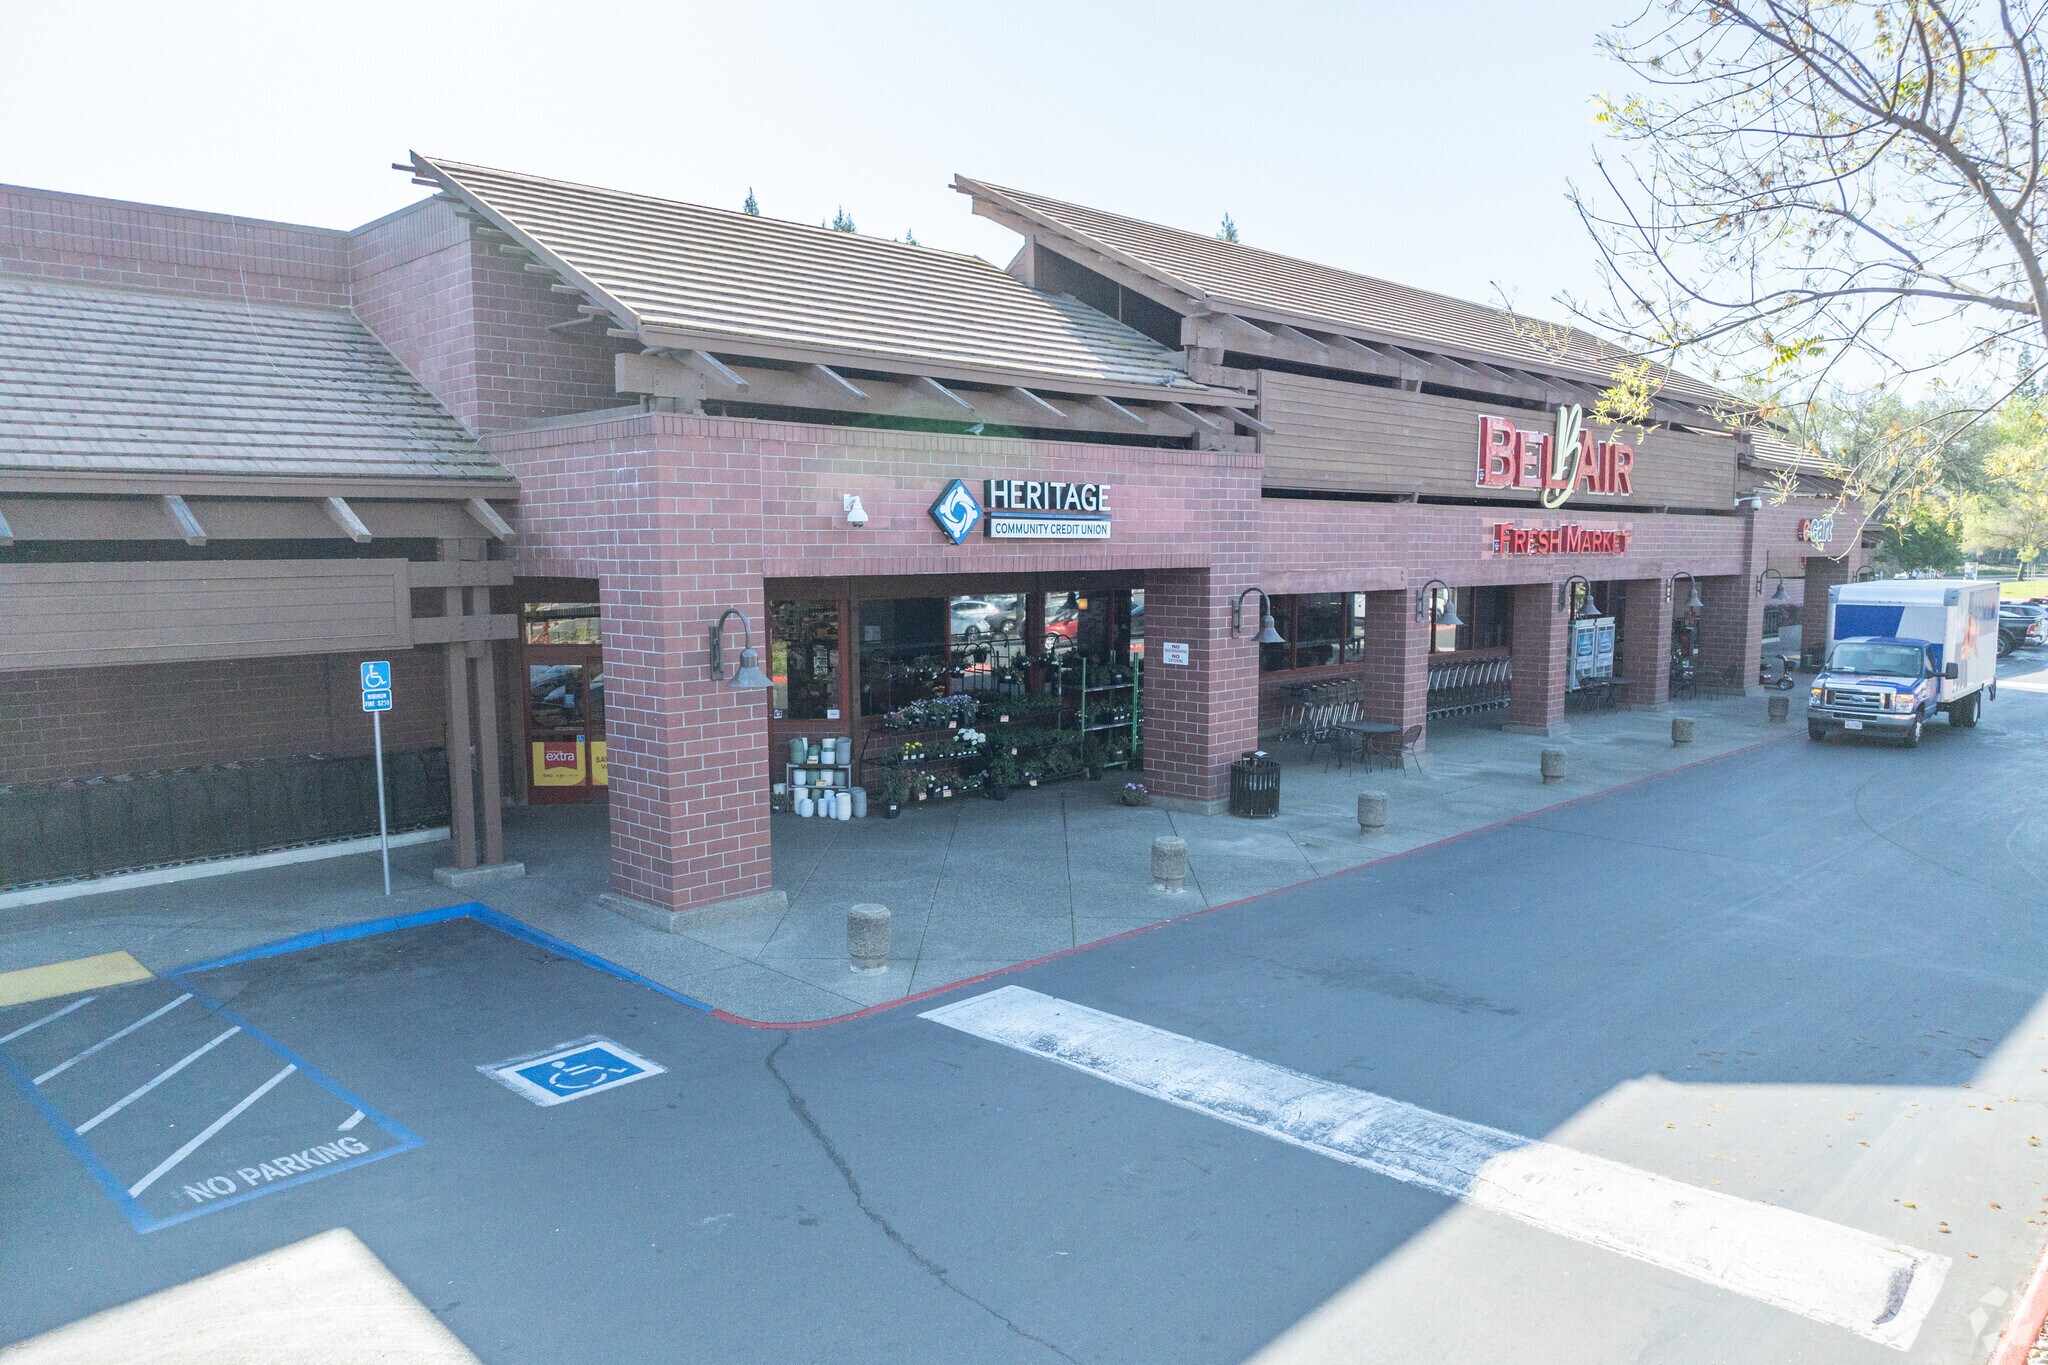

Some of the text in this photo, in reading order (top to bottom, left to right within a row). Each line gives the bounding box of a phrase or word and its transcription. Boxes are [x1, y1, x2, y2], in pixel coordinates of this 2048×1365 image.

[990, 479, 1111, 512] HERITAGE
[995, 522, 1108, 535] COMMUNITY CREDIT UNION
[1494, 522, 1631, 554] FRESH MARKET
[545, 750, 575, 762] extra
[183, 1136, 370, 1203] NO PARKING
